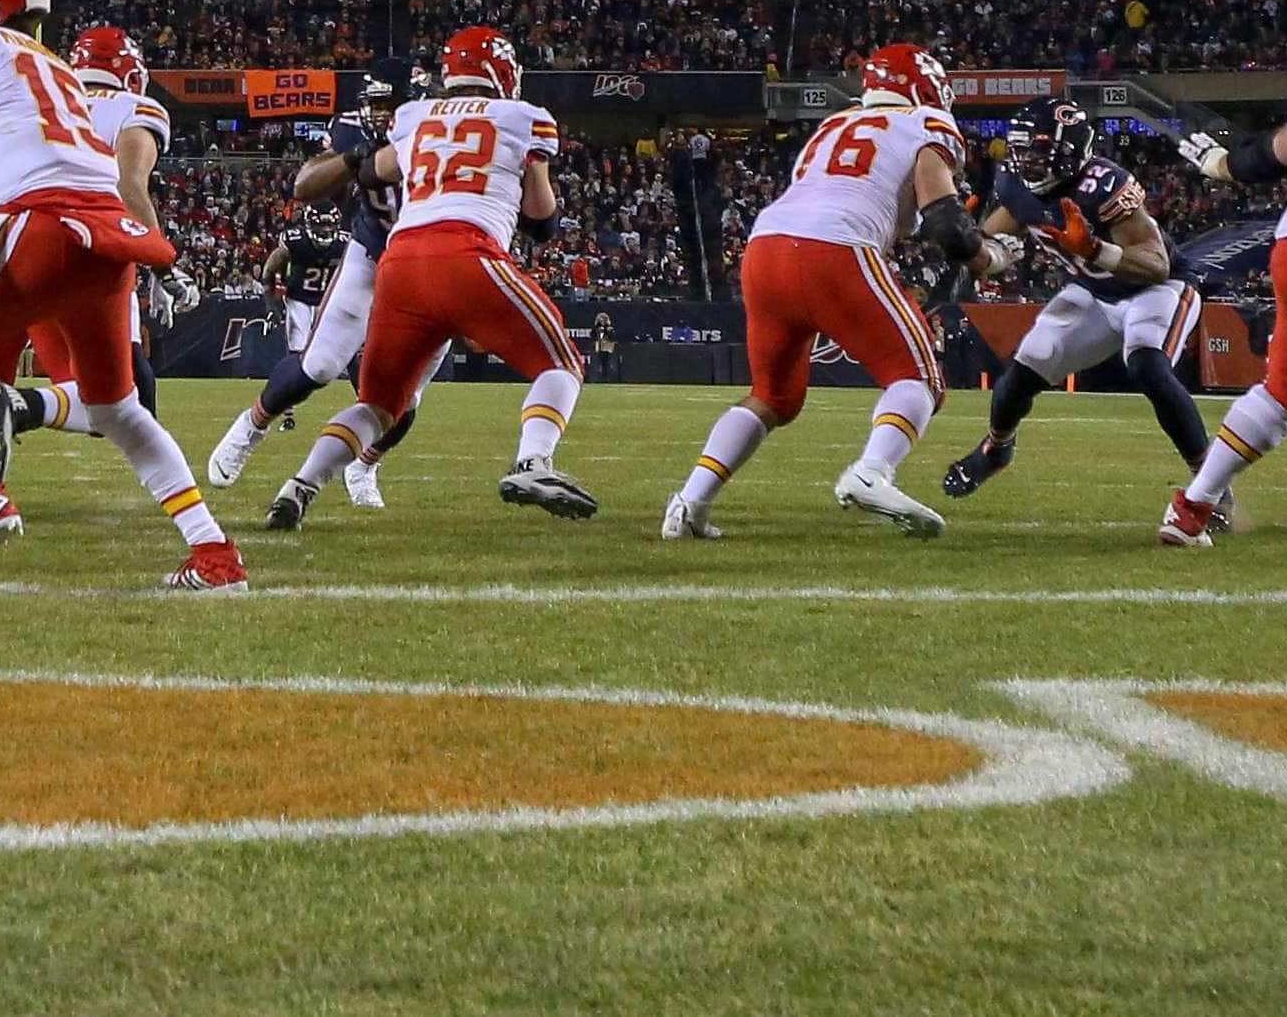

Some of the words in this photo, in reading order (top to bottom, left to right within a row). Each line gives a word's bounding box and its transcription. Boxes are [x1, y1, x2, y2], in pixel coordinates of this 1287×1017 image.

[276, 74, 308, 88] GO
[253, 93, 332, 111] BEARS
[805, 91, 826, 104] 125
[1105, 88, 1127, 102] 126
[14, 51, 115, 159] 15
[429, 101, 490, 117] REITER
[796, 115, 889, 180] 76
[407, 118, 498, 203] 62
[303, 268, 329, 291] 21
[1208, 338, 1229, 353] GSH
